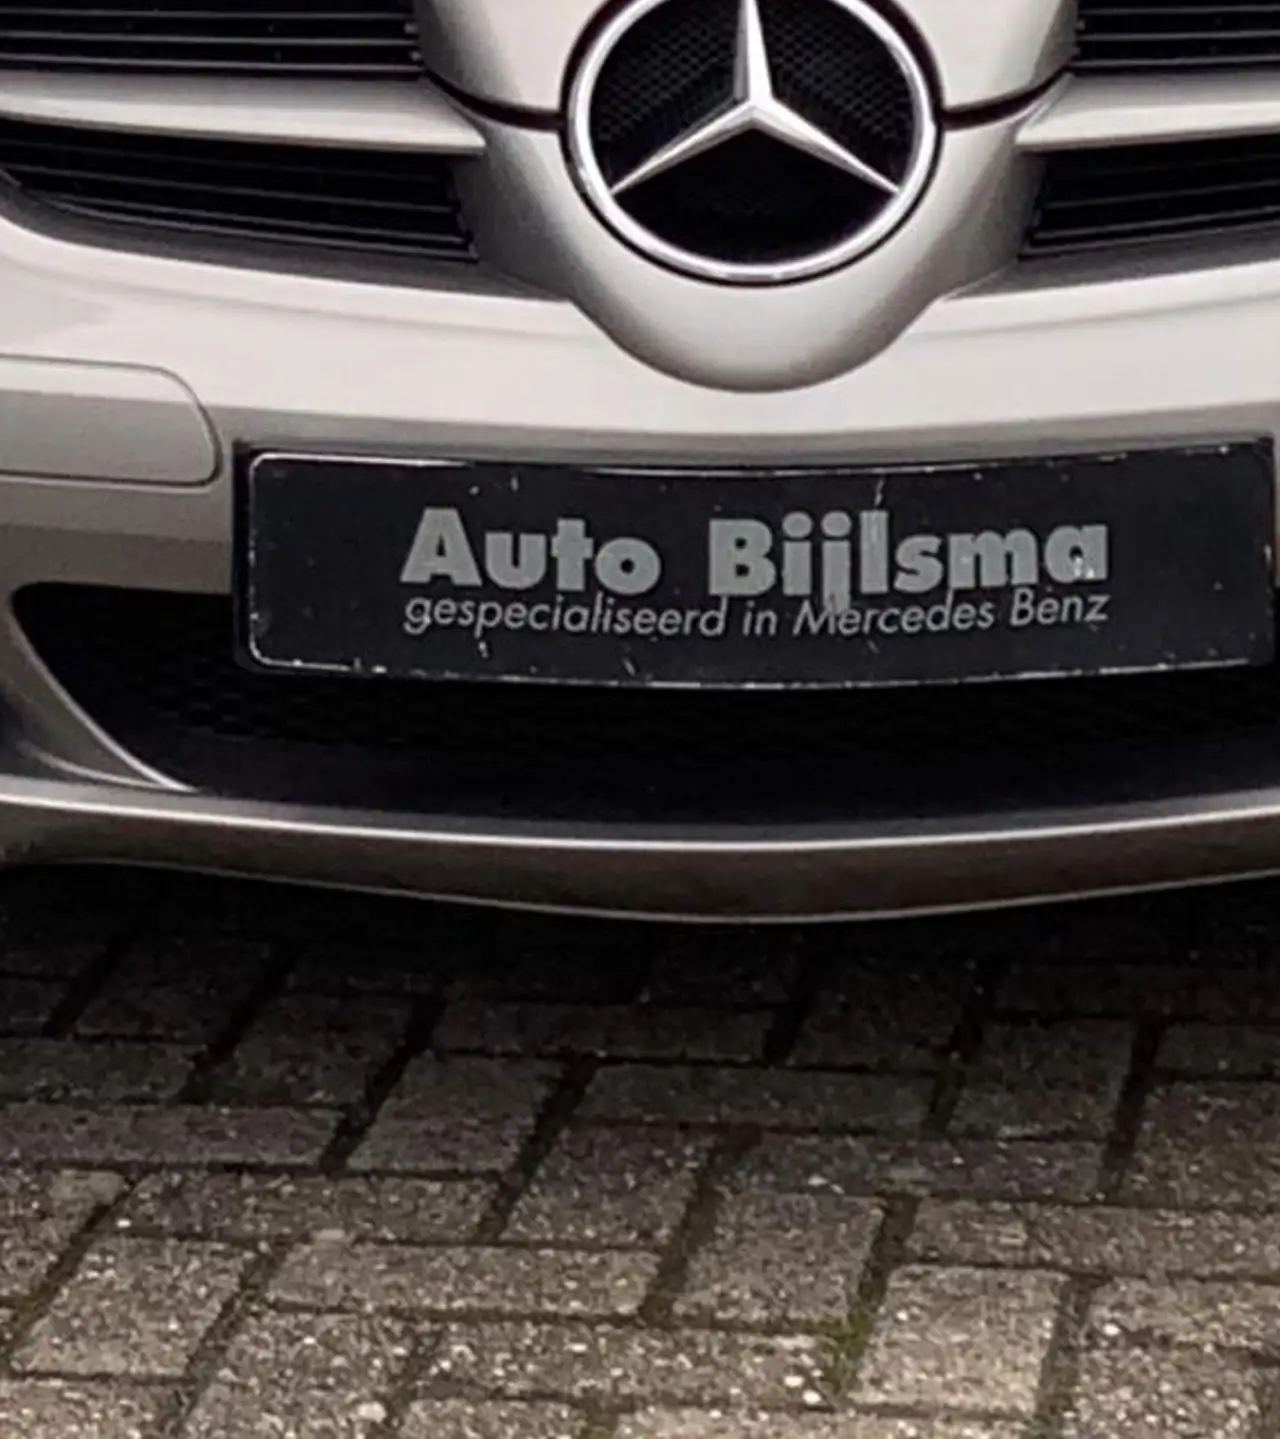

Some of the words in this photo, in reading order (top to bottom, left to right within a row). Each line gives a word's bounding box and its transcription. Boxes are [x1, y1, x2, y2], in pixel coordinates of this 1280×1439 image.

[399, 507, 662, 596] Auto
[708, 509, 1108, 616] Bijlsma
[403, 591, 728, 636] gespecialiseerd
[742, 600, 778, 636] in
[793, 588, 995, 636] Mercedes
[1009, 587, 1111, 626] Benz
